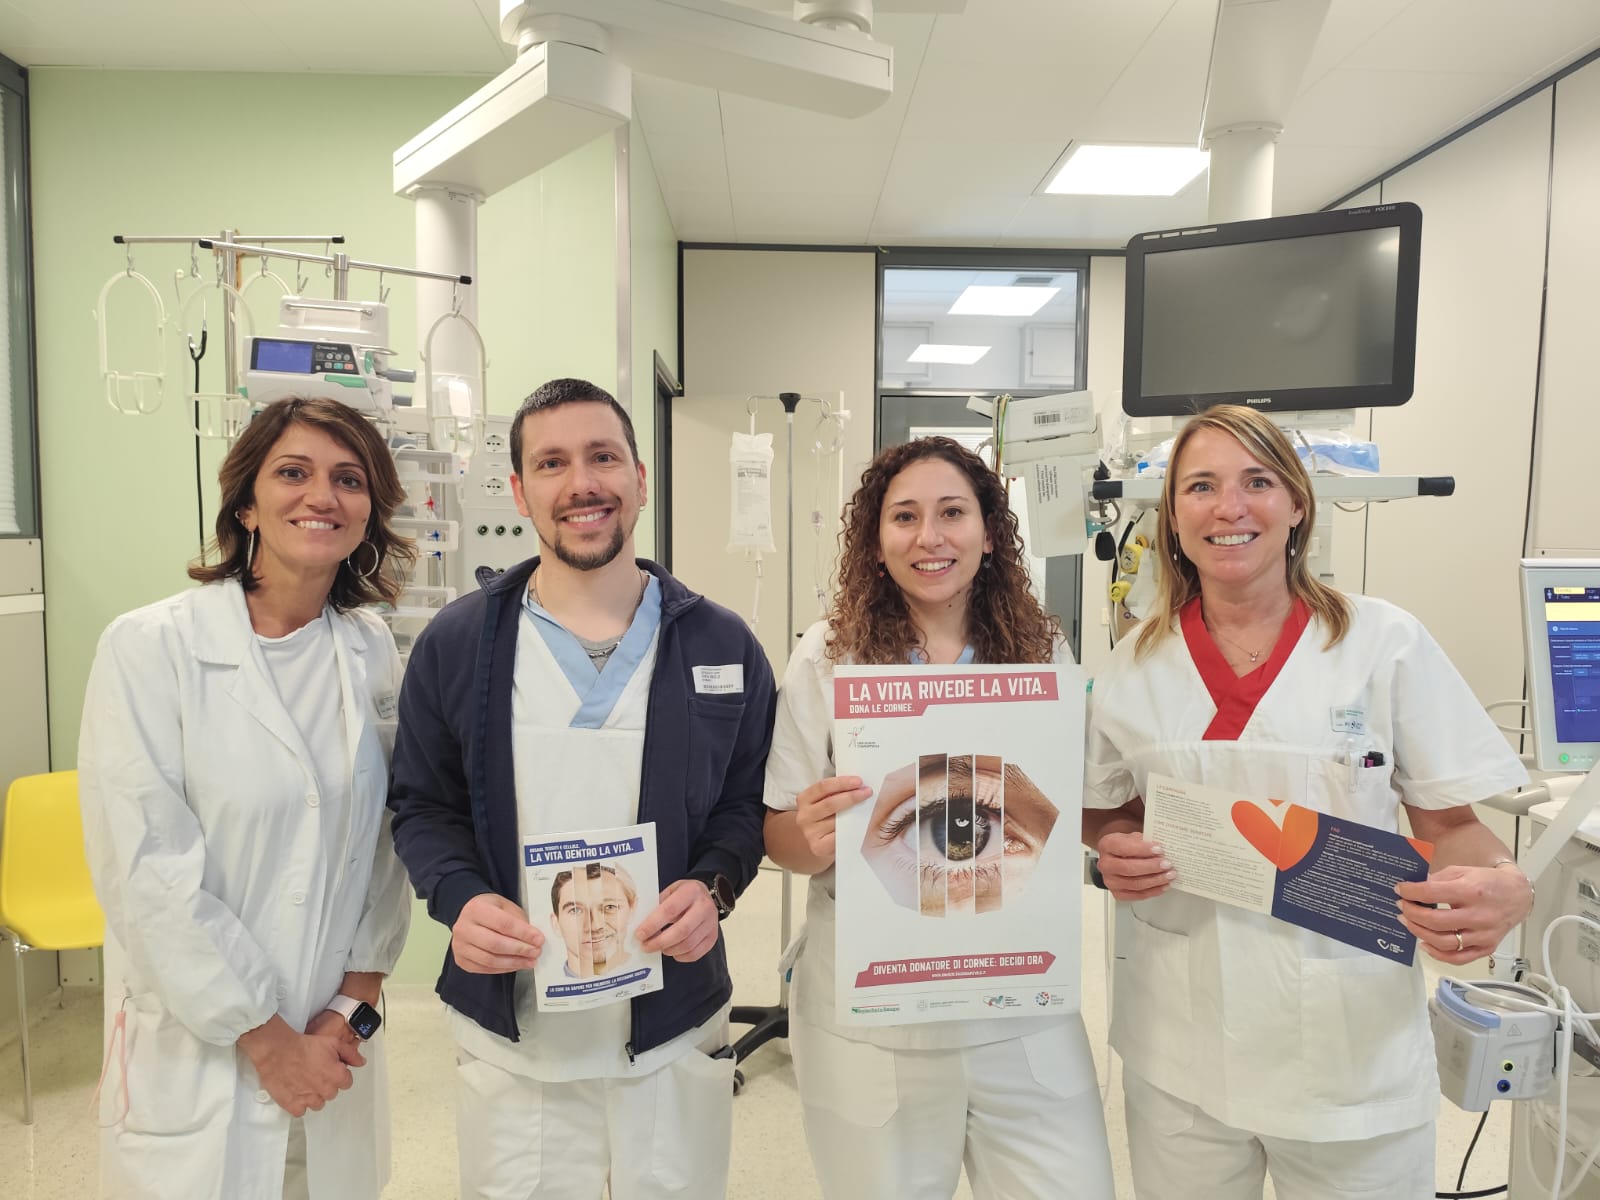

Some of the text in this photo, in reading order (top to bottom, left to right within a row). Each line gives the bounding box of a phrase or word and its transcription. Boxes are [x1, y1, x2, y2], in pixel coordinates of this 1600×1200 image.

[849, 677, 1048, 702] LA VITA RIVEDE LA VITA.
[849, 703, 916, 714] DONA LE CORNEE.
[530, 842, 634, 863] LA VITA DENTRO LA VITA.
[873, 954, 1043, 975] DIVENTA DONATORE DI CORNEE: DECIDI ORA
